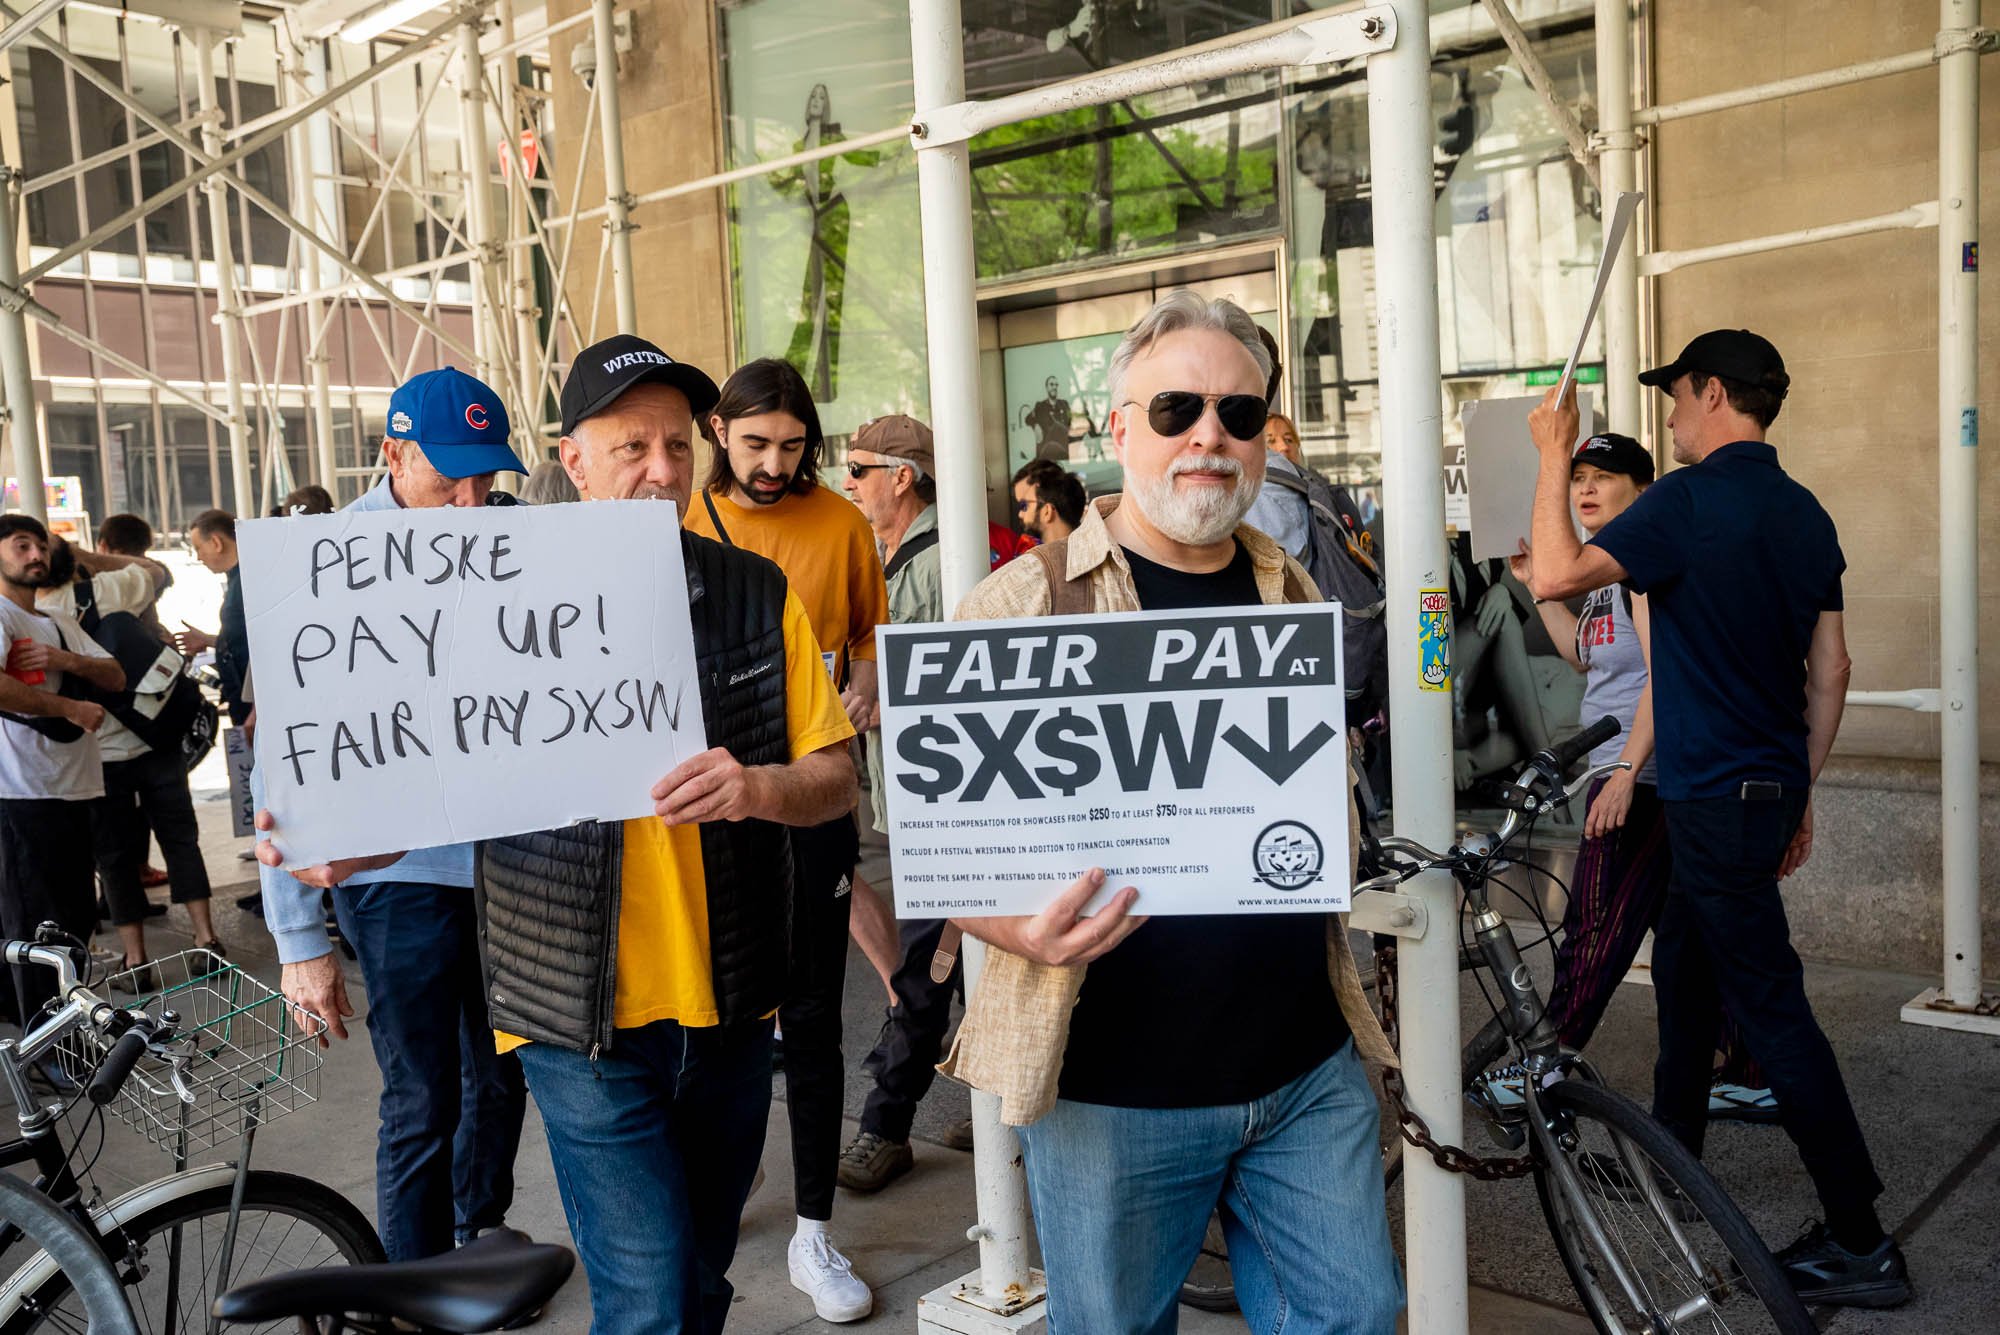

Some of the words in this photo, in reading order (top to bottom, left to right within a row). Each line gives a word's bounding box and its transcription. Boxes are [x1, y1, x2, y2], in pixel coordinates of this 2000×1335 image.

[465, 403, 490, 430] C
[311, 528, 522, 598] PENSKE
[292, 608, 442, 688] PAY
[497, 594, 611, 659] UP!
[904, 633, 1097, 696] FAIR
[1148, 623, 1299, 682] PAY
[1288, 657, 1320, 677] AT
[282, 700, 432, 786] FAIR
[453, 689, 530, 754] PAY
[541, 678, 684, 743] SXSW
[896, 697, 1224, 804] $X$W
[900, 820, 934, 829] INCREASE
[936, 820, 950, 829] THE
[951, 818, 1006, 829] COMPENSATION
[1007, 817, 1022, 826] FOR
[1023, 815, 1066, 825] SHOWCASES
[1067, 813, 1087, 823] FROM
[1089, 807, 1110, 821] $250
[1111, 810, 1121, 819] TO
[1122, 810, 1132, 818] AT
[1133, 809, 1154, 818] LEAST
[1156, 804, 1178, 818] $750
[1179, 808, 1193, 816] FOR
[1195, 807, 1207, 816] ALL
[1209, 806, 1256, 815] PERFORMERS
[902, 847, 932, 856] INCLUDE
[934, 847, 939, 855] A
[941, 847, 973, 855] FESTIVAL
[975, 846, 1016, 855] WRISTBAND
[1018, 845, 1027, 854] IN
[1029, 844, 1064, 854] ADDITION
[1066, 843, 1075, 852] TO
[1077, 840, 1114, 850] FINANCIAL
[1116, 837, 1170, 847] COMPENSATION
[904, 874, 934, 882] PROVIDE
[936, 874, 949, 882] THE
[952, 874, 969, 882] SAME
[972, 873, 985, 881] PAY
[994, 872, 1036, 881] WRISTBAND
[1038, 871, 1055, 880] DEAL
[1057, 872, 1066, 880] TO
[1068, 868, 1123, 880] INTONAL
[1126, 866, 1140, 875] AND
[1142, 865, 1177, 874] DOMESTIC
[1179, 864, 1209, 873] ARTISTS
[906, 900, 920, 908] END
[922, 900, 935, 908] THE
[937, 899, 983, 908] APPLICATION
[985, 899, 997, 907] FEE
[1238, 897, 1342, 906] WWW.WEAREUMAW.ORG
